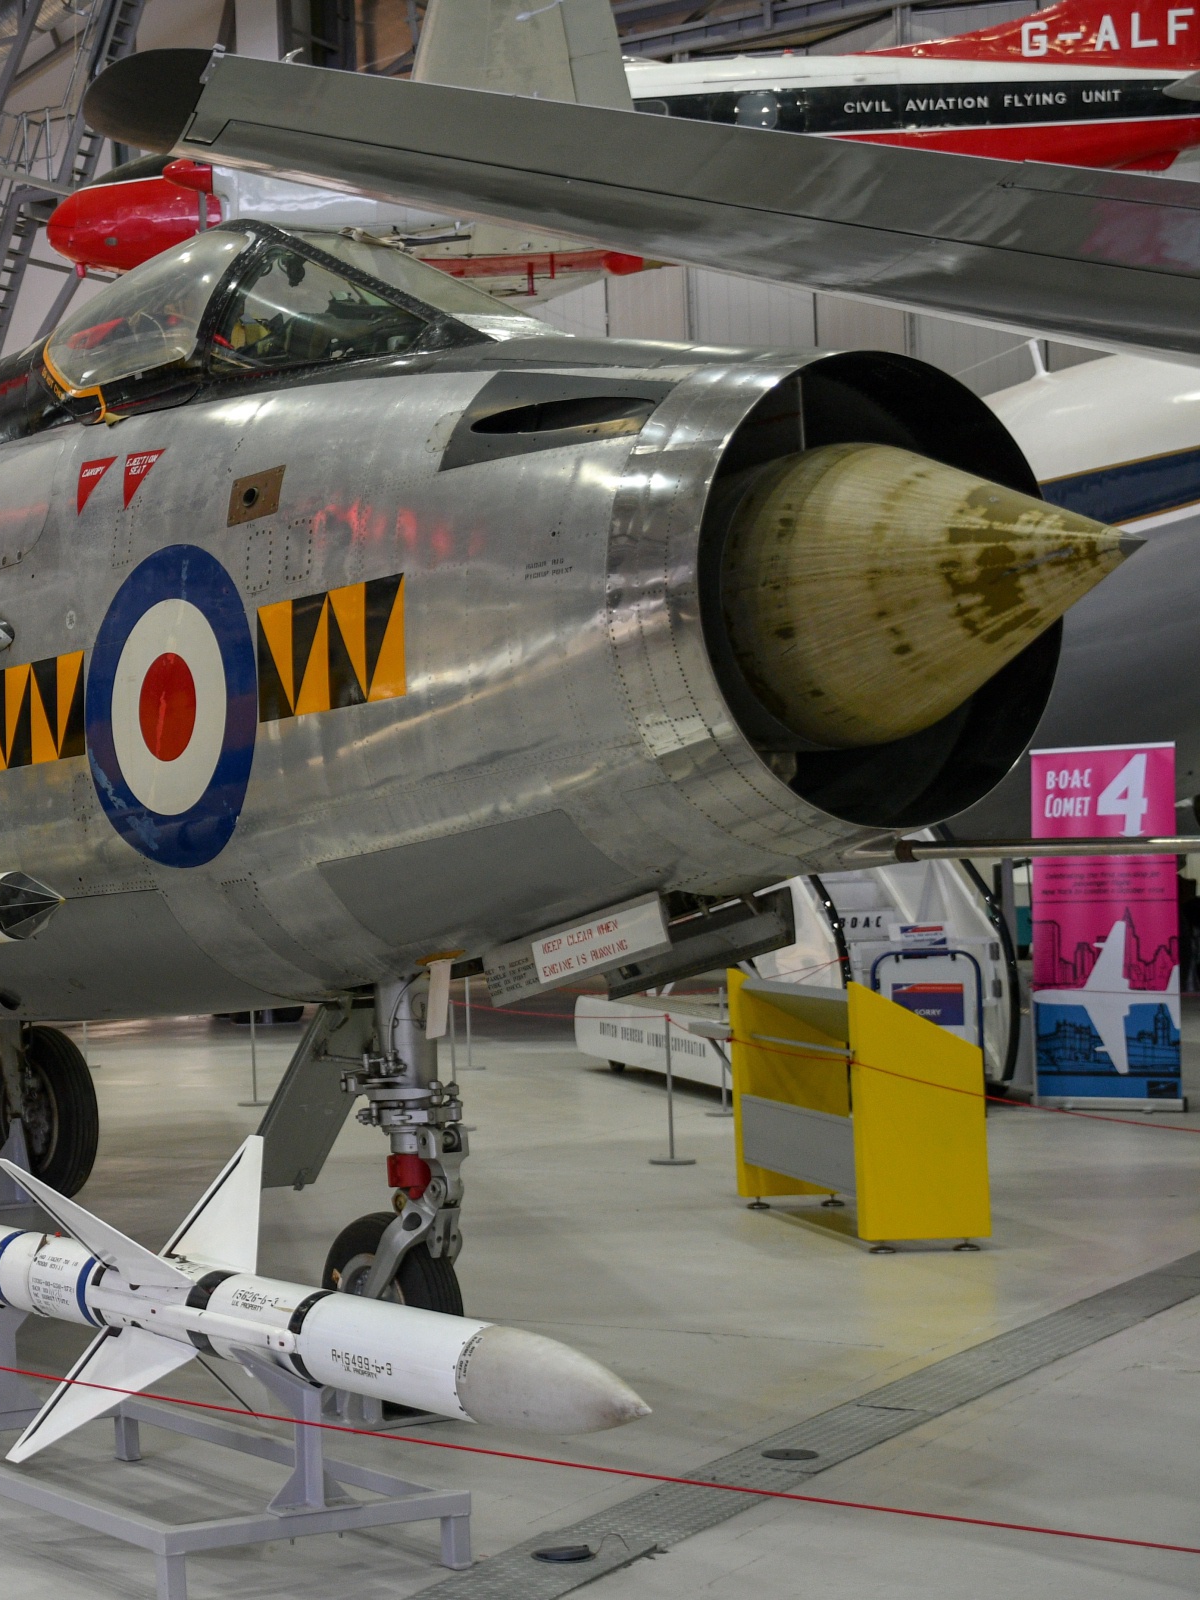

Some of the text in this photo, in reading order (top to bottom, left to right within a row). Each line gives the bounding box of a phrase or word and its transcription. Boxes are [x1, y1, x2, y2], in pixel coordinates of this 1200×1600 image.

[843, 89, 1122, 114] CIVIL AVIATION FLYING UNIT
[126, 454, 158, 466] EJECTION
[81, 466, 106, 478] CANOPY
[128, 465, 146, 476] SEAT
[1096, 753, 1148, 837] 4
[542, 919, 619, 955] KEEP CLEAR WHEN
[542, 939, 629, 978] ENGINE IS RUNNING
[241, 1302, 264, 1312] PROPERTY
